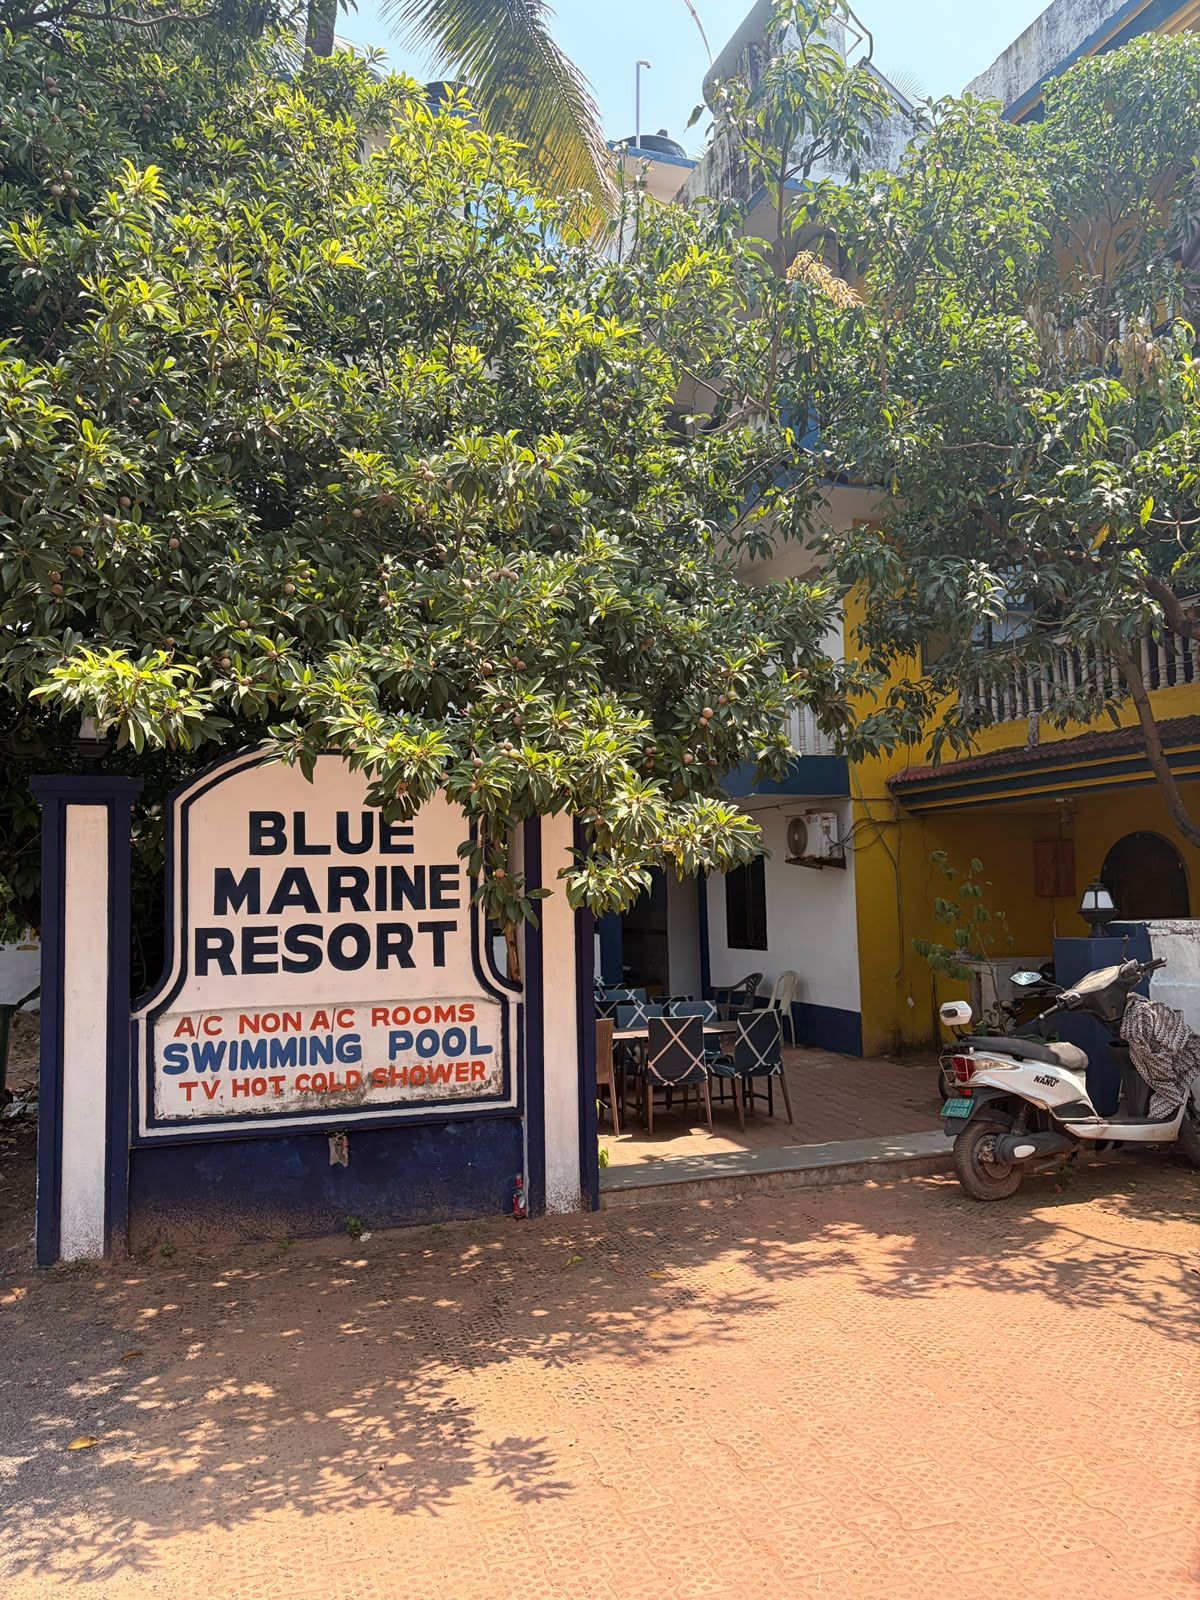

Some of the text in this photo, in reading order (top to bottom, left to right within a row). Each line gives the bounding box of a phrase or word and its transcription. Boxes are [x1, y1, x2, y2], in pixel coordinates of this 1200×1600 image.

[249, 811, 414, 855] BLUE
[213, 864, 460, 915] MARINE
[194, 920, 457, 976] RESORT
[173, 1003, 476, 1040] A/C NON A/C ROOMS
[162, 1025, 494, 1076] SWIMMING POOL
[231, 1075, 287, 1099] HOT
[294, 1070, 362, 1094] COLD
[371, 1060, 487, 1090] SHOWER
